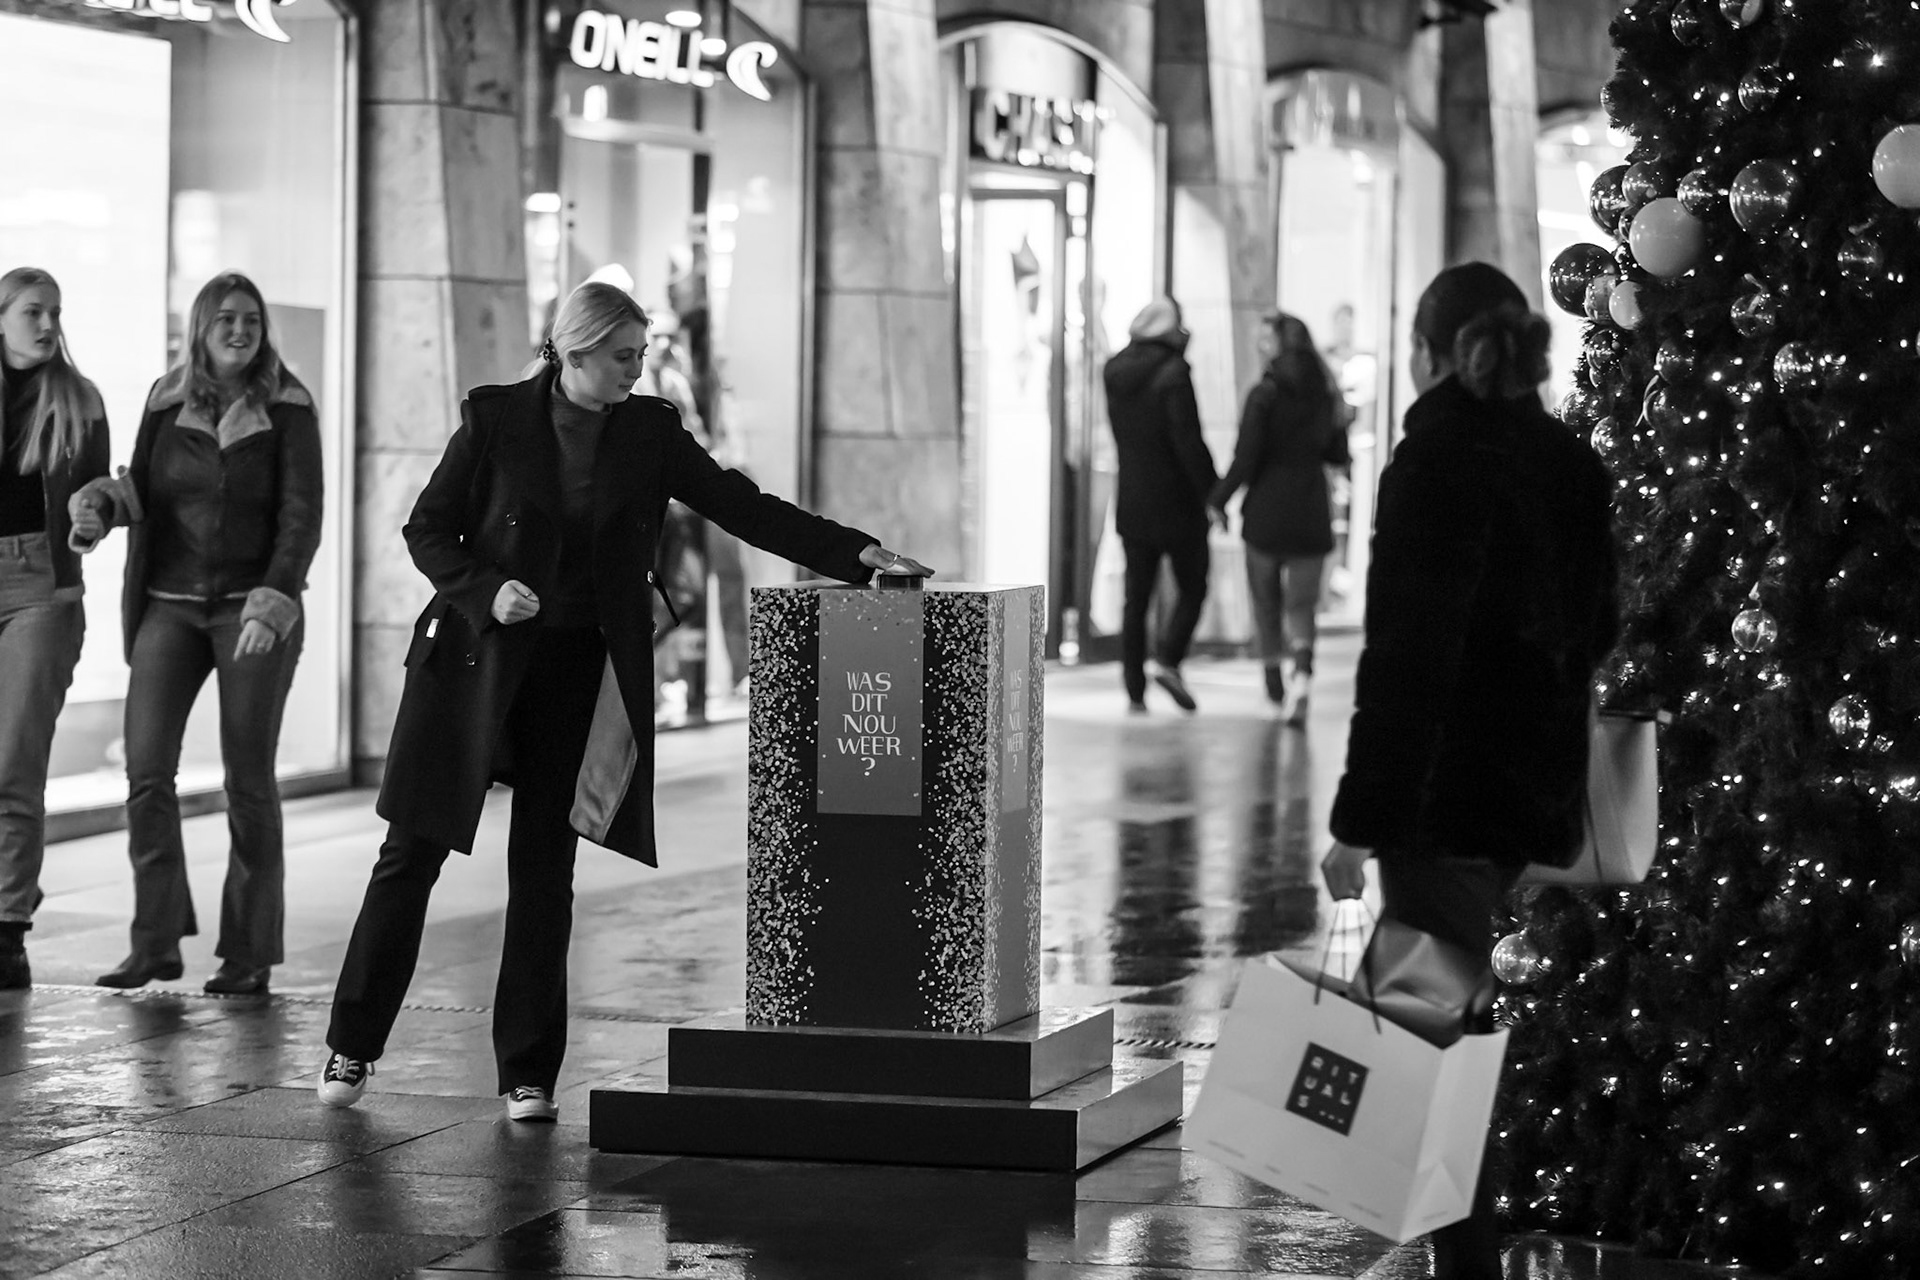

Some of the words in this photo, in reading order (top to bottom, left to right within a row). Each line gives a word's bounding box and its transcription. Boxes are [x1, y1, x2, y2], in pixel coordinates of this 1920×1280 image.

[846, 671, 892, 692] WAS
[851, 693, 888, 712] DIT
[842, 713, 896, 734] NOU
[836, 736, 902, 756] WEER
[861, 757, 876, 776] ?
